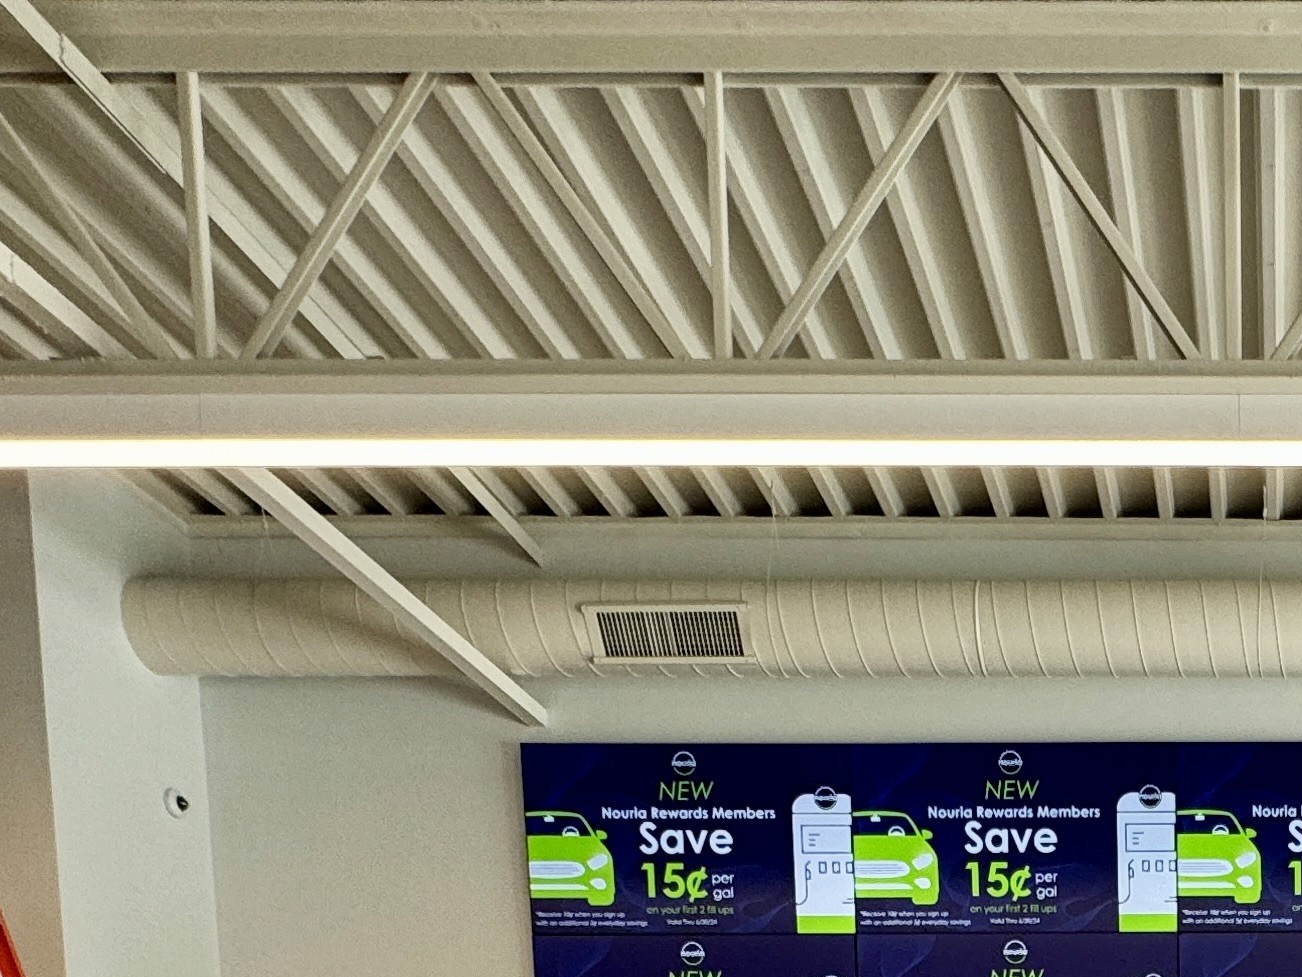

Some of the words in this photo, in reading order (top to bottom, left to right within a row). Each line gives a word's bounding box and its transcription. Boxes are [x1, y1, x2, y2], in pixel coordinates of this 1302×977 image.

[659, 781, 714, 801] NEW
[985, 780, 1040, 800] NEW
[602, 807, 647, 819] Nouria
[651, 807, 708, 820] Rewards
[711, 807, 776, 820] Members
[928, 806, 972, 819] Nouria
[976, 806, 1034, 819] Rewards
[1037, 806, 1100, 818] Members
[1252, 805, 1297, 818] Nouria
[639, 821, 734, 855] Save
[964, 820, 1058, 854] Save
[641, 862, 708, 902] 15¢
[712, 874, 735, 885] per
[965, 861, 1032, 901] 15¢
[1035, 872, 1058, 883] per
[713, 888, 734, 901] gal
[1037, 887, 1057, 899] gal
[661, 907, 680, 915] your
[683, 905, 697, 914] first
[699, 906, 705, 914] 2
[707, 905, 716, 914] fill
[718, 907, 734, 915] ups
[984, 906, 1003, 914] your
[1006, 904, 1020, 912] first
[1030, 904, 1038, 912] fill
[1041, 906, 1057, 914] ups
